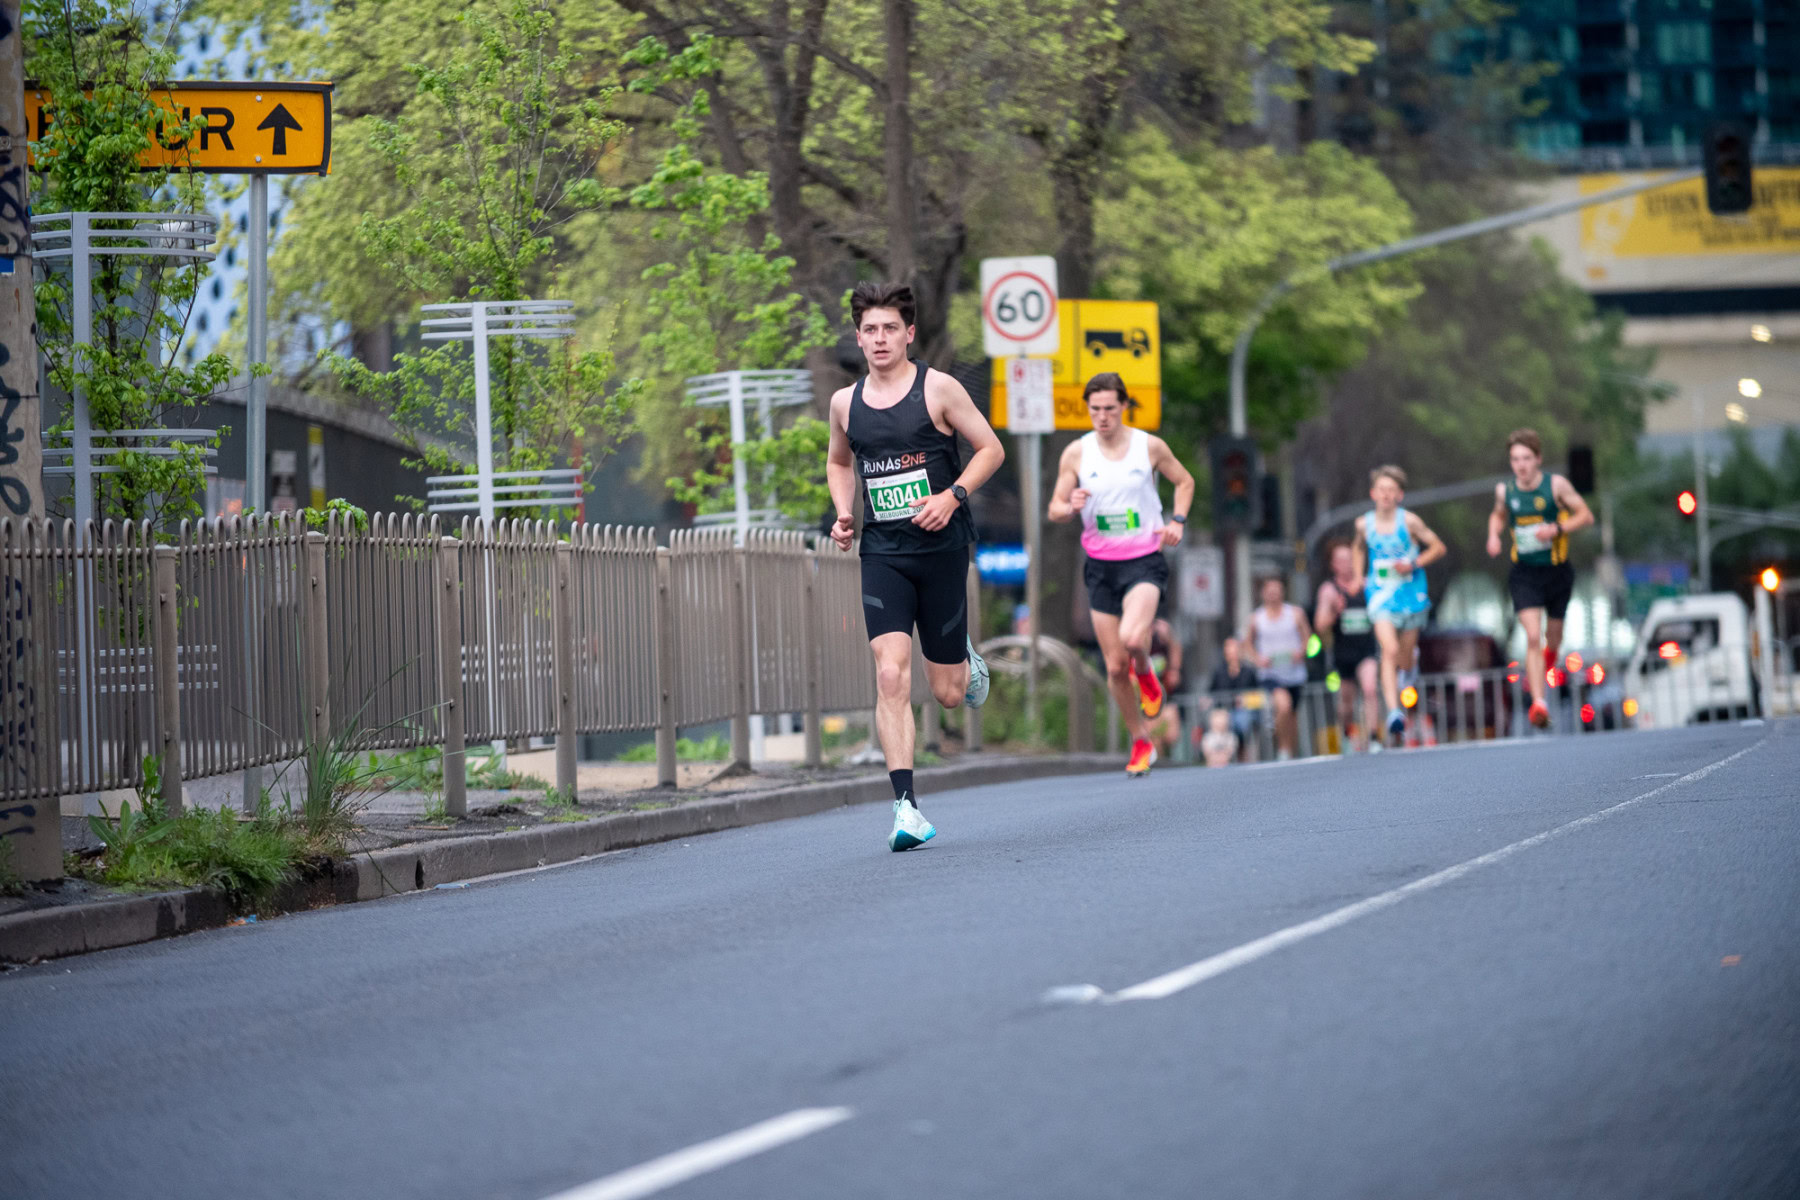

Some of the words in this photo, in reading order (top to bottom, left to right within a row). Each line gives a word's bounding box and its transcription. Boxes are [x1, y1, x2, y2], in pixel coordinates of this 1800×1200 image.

[997, 289, 1045, 323] 60
[877, 482, 922, 509] 43041
[879, 510, 911, 519] MELBOURNE
